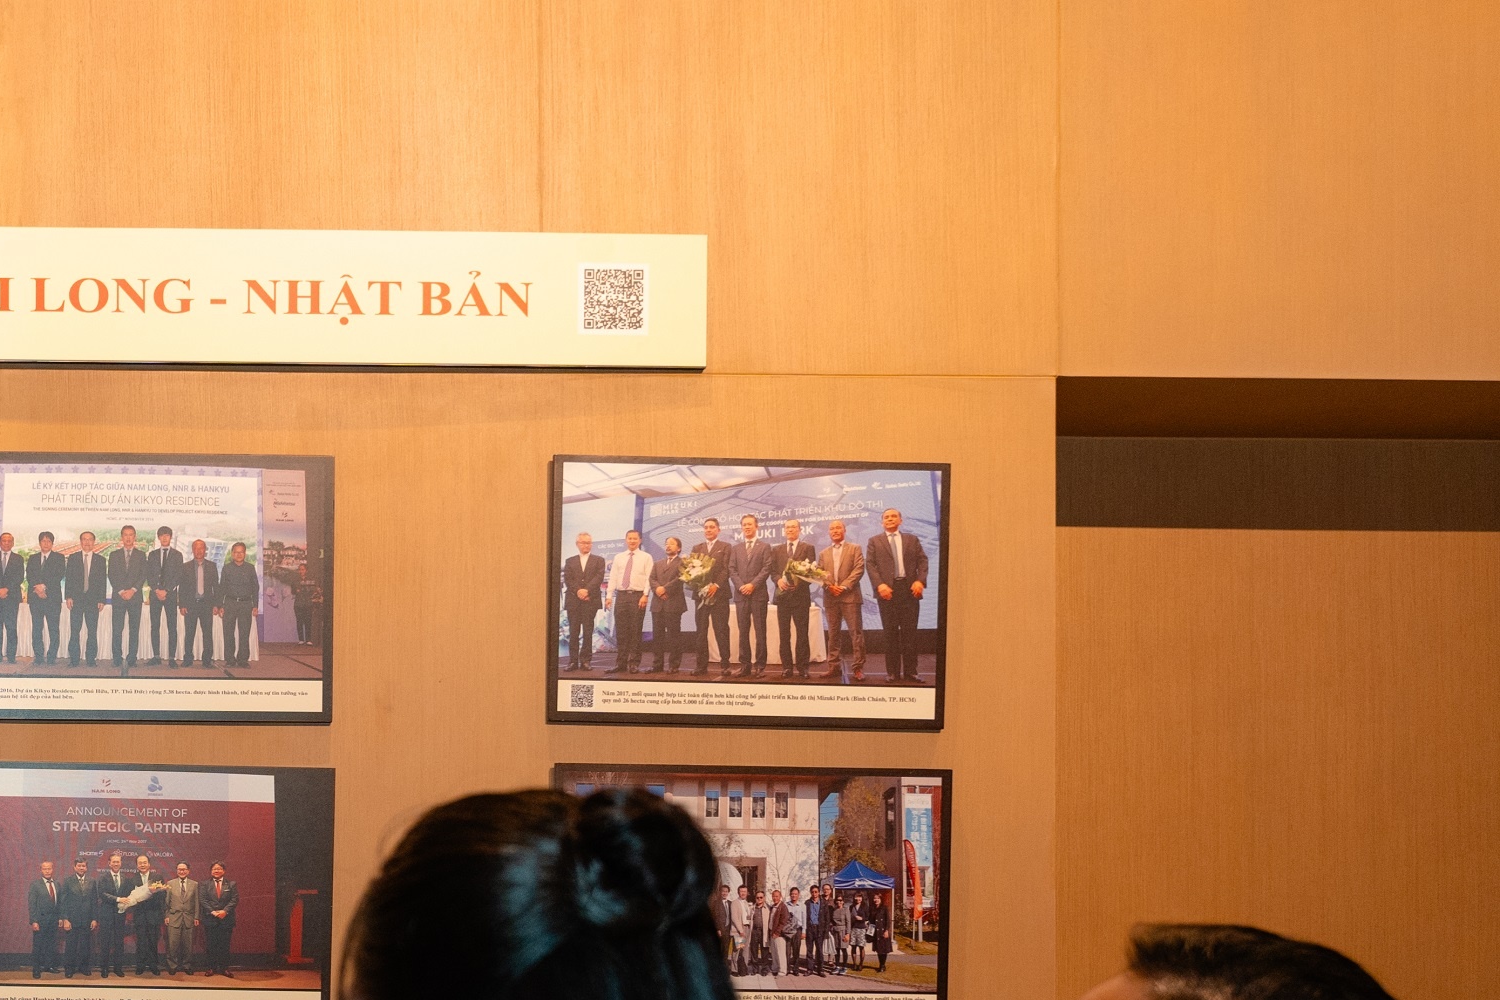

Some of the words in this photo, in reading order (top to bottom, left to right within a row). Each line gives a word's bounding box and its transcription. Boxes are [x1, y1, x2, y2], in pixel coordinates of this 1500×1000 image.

[30, 277, 194, 314] LONG
[242, 274, 402, 326] NHẬT
[418, 270, 533, 318] BẢN
[42, 481, 53, 490] KÝ
[54, 481, 68, 490] KẾT
[71, 483, 87, 492] HỢP
[90, 482, 104, 491] TÁC
[106, 482, 125, 491] GIỮA
[127, 484, 146, 492] NAM
[147, 485, 170, 493] LONG,
[41, 492, 67, 503] PHÁT
[69, 491, 98, 504] TRIỂN
[100, 495, 115, 506] DỰ
[117, 493, 131, 505] ÁN
[133, 496, 163, 505] KIKYO
[165, 496, 220, 506] RESIDENCE
[66, 807, 169, 817] ANNOUNCEMENT
[171, 808, 188, 818] OF
[52, 821, 131, 833] STRATEGIC
[135, 822, 201, 834] PARTNER
